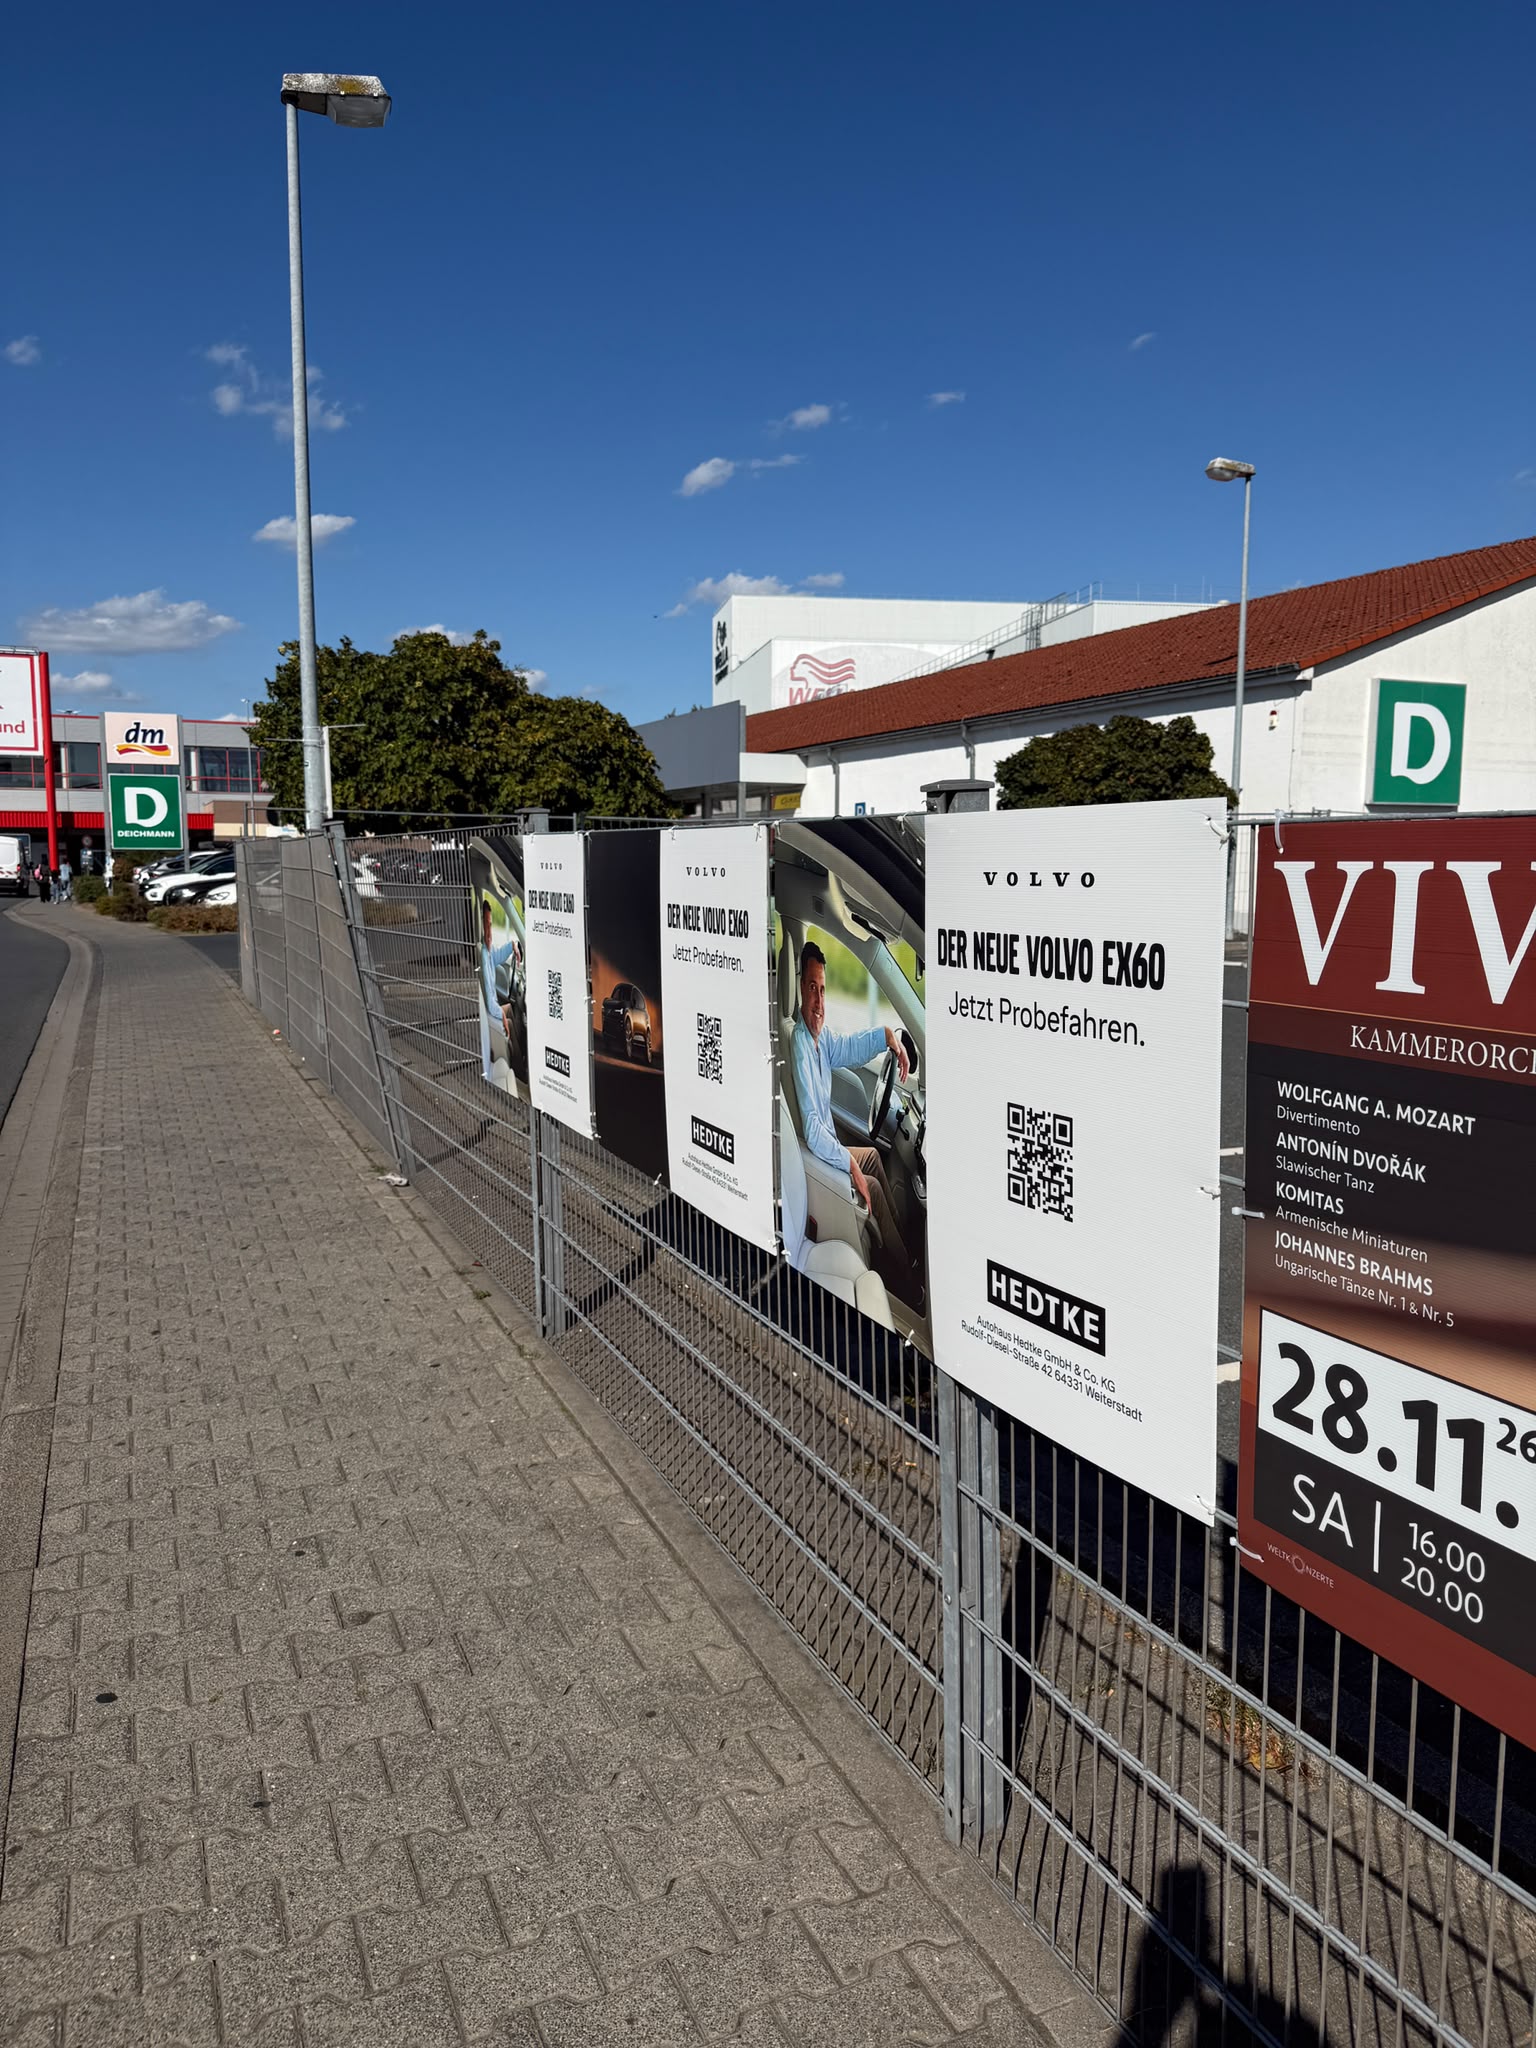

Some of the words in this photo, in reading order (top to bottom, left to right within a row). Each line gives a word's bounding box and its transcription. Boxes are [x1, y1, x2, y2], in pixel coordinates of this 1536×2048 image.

[125, 722, 164, 743] dm
[1391, 701, 1451, 784] D
[124, 787, 168, 827] D
[117, 830, 175, 838] DEICHMANN
[540, 862, 563, 870] VOLVO
[686, 866, 726, 877] VOLVO
[983, 871, 1095, 887] VOLVO
[528, 889, 537, 908] DER
[667, 903, 681, 929] DER
[682, 904, 701, 932] NEUE
[702, 906, 726, 935] VOLVO
[728, 909, 749, 939] EX60
[672, 943, 691, 962] Jetzt
[693, 946, 744, 973] Probefahren.
[937, 928, 967, 969] DER
[973, 931, 1019, 975] NEUE
[1026, 935, 1093, 983] VOLVO
[1102, 940, 1165, 990] EX60
[949, 991, 993, 1022] Jetzt
[999, 997, 1145, 1046] Probefahren.
[546, 1050, 570, 1073] HEDTKE
[1350, 1025, 1536, 1075] KAMMERORC
[1276, 1105, 1360, 1135] Divertimento
[1277, 1080, 1369, 1114] WOLFGANG
[1373, 1100, 1391, 1119] A.
[1396, 1104, 1476, 1136] MOZART
[692, 1121, 733, 1158] HEDTKE
[1276, 1132, 1348, 1164] ANTONÍN
[1353, 1149, 1426, 1183] DVOŘÁK
[1276, 1155, 1341, 1184] Slawischer
[1344, 1172, 1375, 1194] Tanz
[1276, 1181, 1344, 1215] KOMITAS
[1276, 1205, 1348, 1238] Armenische
[1352, 1228, 1428, 1263] Miniaturen
[1275, 1230, 1355, 1270] JOHANNES
[1360, 1258, 1433, 1296] BRAHMS
[991, 1269, 1100, 1345] HEDTKE
[1275, 1253, 1337, 1287] Ungarische
[1340, 1276, 1375, 1300] Tänze
[1378, 1289, 1397, 1308] Nr.
[1400, 1296, 1406, 1310] 1
[1409, 1301, 1419, 1316] &
[1422, 1306, 1441, 1324] Nr.
[1446, 1312, 1454, 1327] 5
[961, 1320, 1040, 1370] Rudolf-Diesel-Straße
[1041, 1363, 1053, 1378] 42
[1055, 1370, 1083, 1393] 64331
[1085, 1384, 1143, 1422] Weiterstadt
[977, 1315, 1012, 1342] Autohaus
[1013, 1333, 1042, 1357] Hedtke
[1043, 1349, 1072, 1371] GmbH
[1074, 1364, 1082, 1377] &
[1083, 1368, 1098, 1385] Co.
[1101, 1376, 1116, 1393] KG
[1292, 1473, 1353, 1548] SA
[1267, 1543, 1335, 1589] WELTKONZERTE
[1408, 1522, 1486, 1583] 16.00
[1401, 1557, 1484, 1623] 20.00
